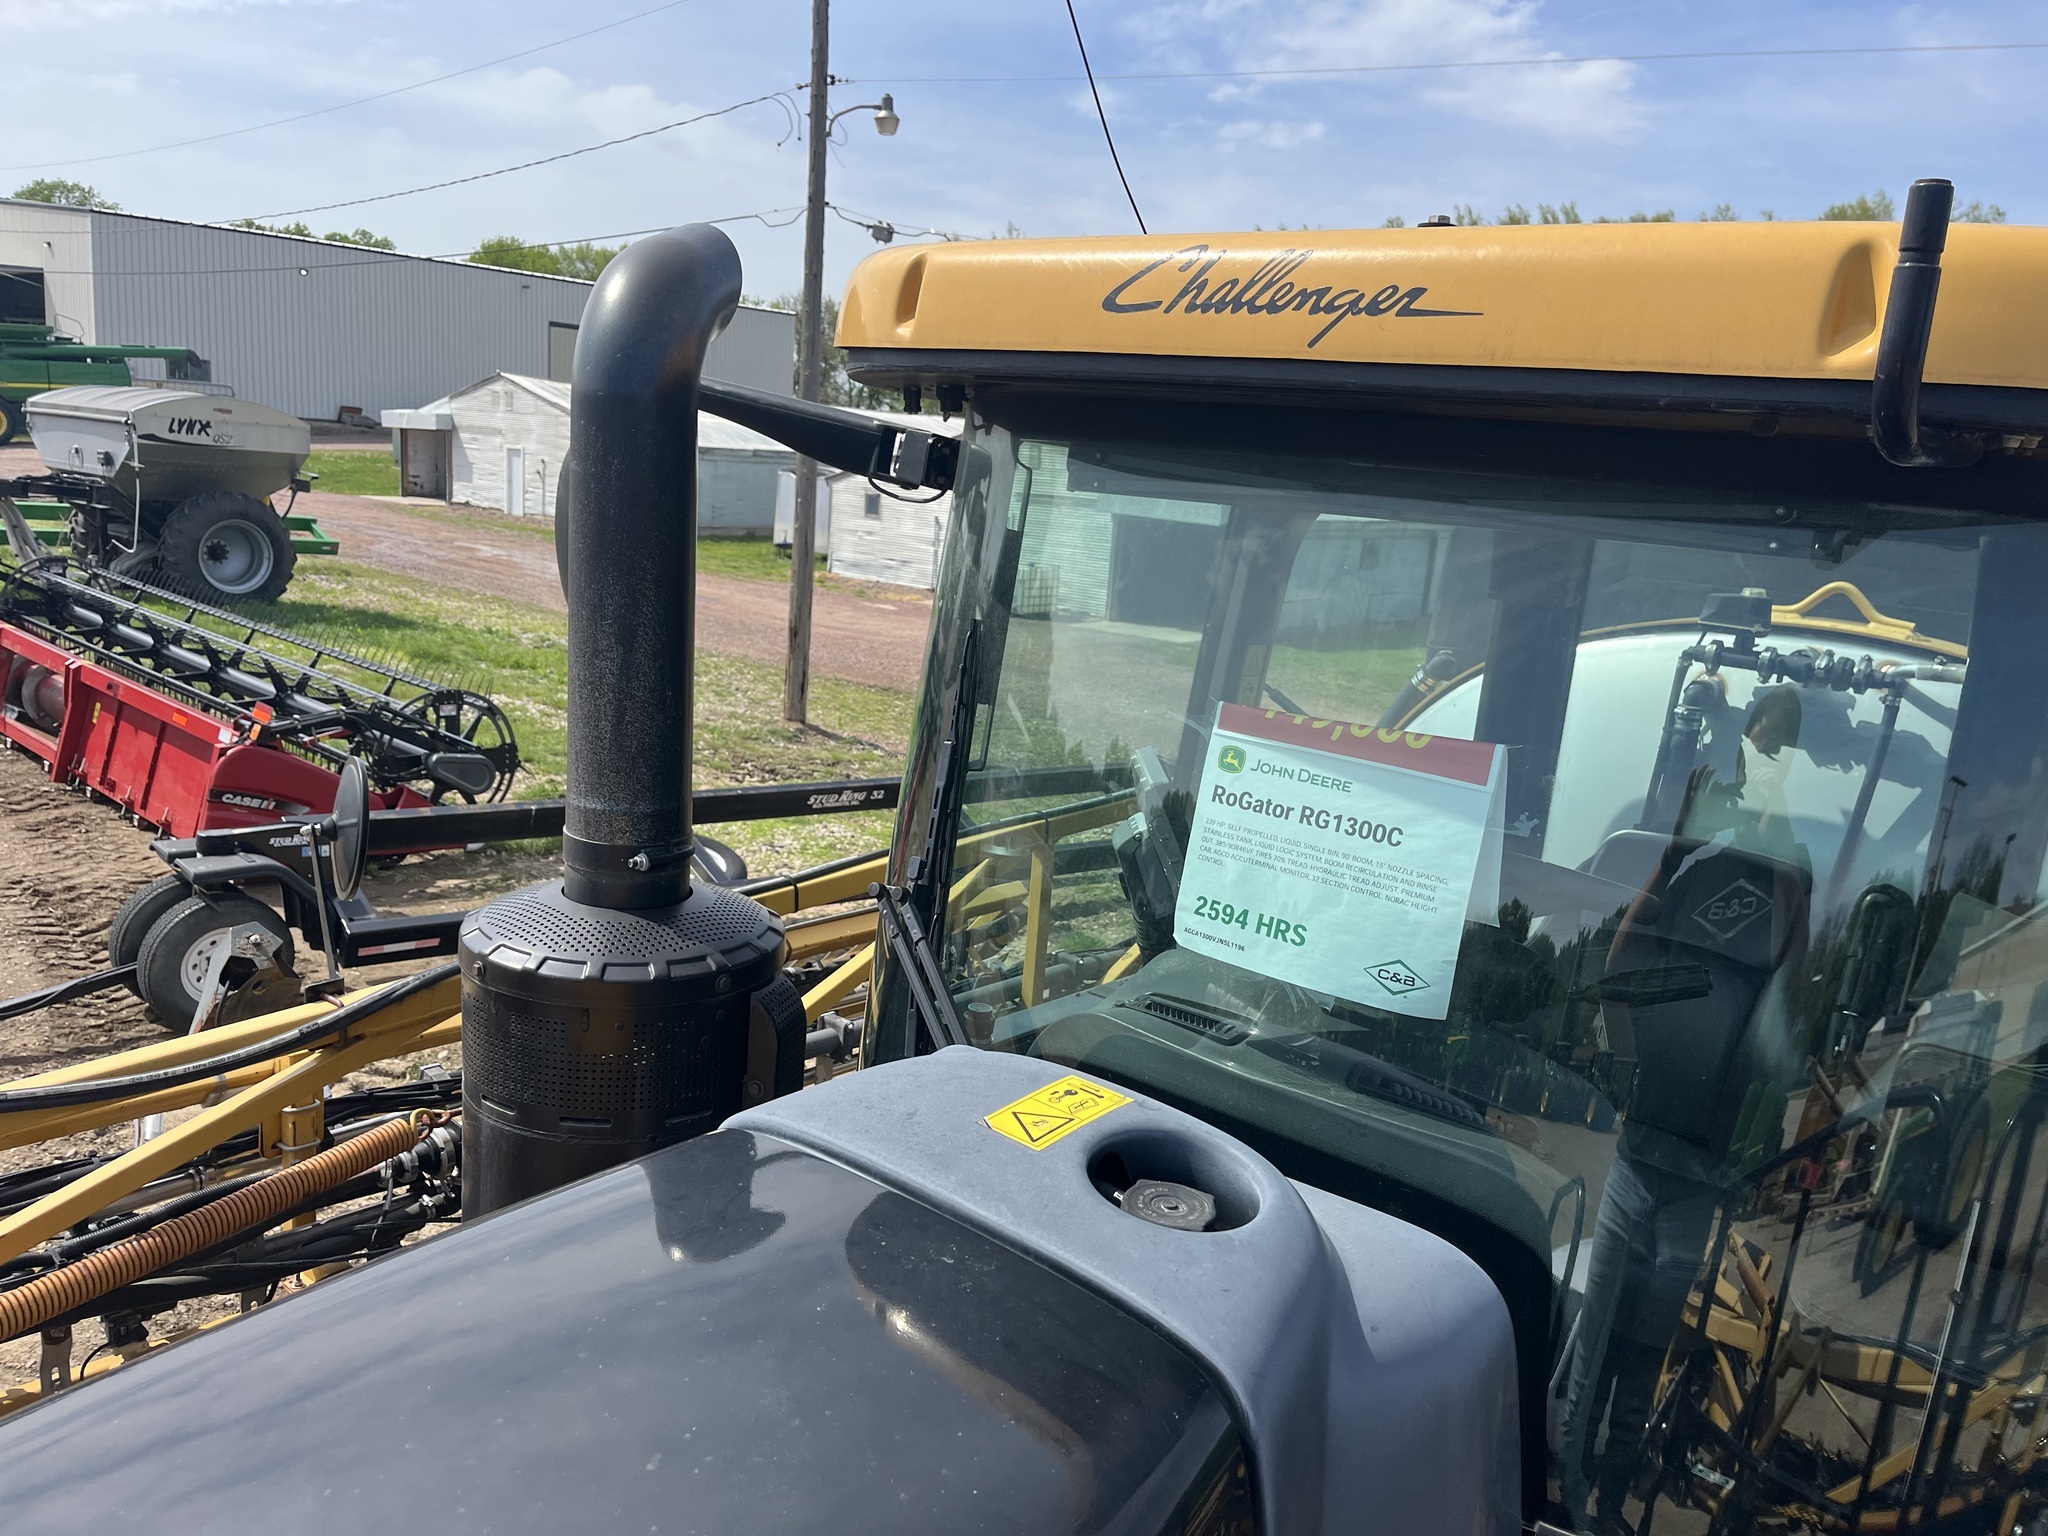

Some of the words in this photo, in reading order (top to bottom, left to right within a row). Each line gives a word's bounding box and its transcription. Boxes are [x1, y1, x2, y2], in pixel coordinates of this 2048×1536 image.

[1101, 244, 1484, 349] Challenger
[168, 416, 212, 437] LYNX
[222, 794, 262, 808] CASE
[807, 794, 839, 805] STUD
[1250, 759, 1294, 780] JOHN
[1298, 768, 1353, 793] DEERE
[1212, 784, 1294, 820] RoGator
[1298, 805, 1404, 848] RG1300C
[1198, 854, 1224, 866] CONTROL
[1203, 827, 1234, 840] STAINLESS
[1255, 840, 1275, 850] LIQUID
[1276, 846, 1294, 855] LOGIC
[1324, 858, 1344, 868] BOOM
[1345, 864, 1398, 882] RECIRCULATION
[1400, 878, 1415, 887] AND
[1417, 882, 1437, 892] RINSE
[1227, 824, 1242, 832] SELF
[1303, 843, 1326, 853] SINGLE
[1387, 864, 1414, 876] NOZZLE
[1213, 849, 1230, 857] AGCO
[1231, 853, 1278, 870] ACCUTERMINAL
[1321, 877, 1349, 889] SECTION
[1385, 894, 1410, 906] NORAC
[1411, 902, 1437, 913] HEIGHT
[1255, 850, 1272, 859] TIRES
[1310, 865, 1346, 879] HYDRAULIC
[1349, 875, 1370, 885] TREAD
[1401, 888, 1434, 902] PREMIUM
[1194, 896, 1250, 930] 2594
[1254, 913, 1308, 946] HRS
[1378, 968, 1416, 986] C&B
